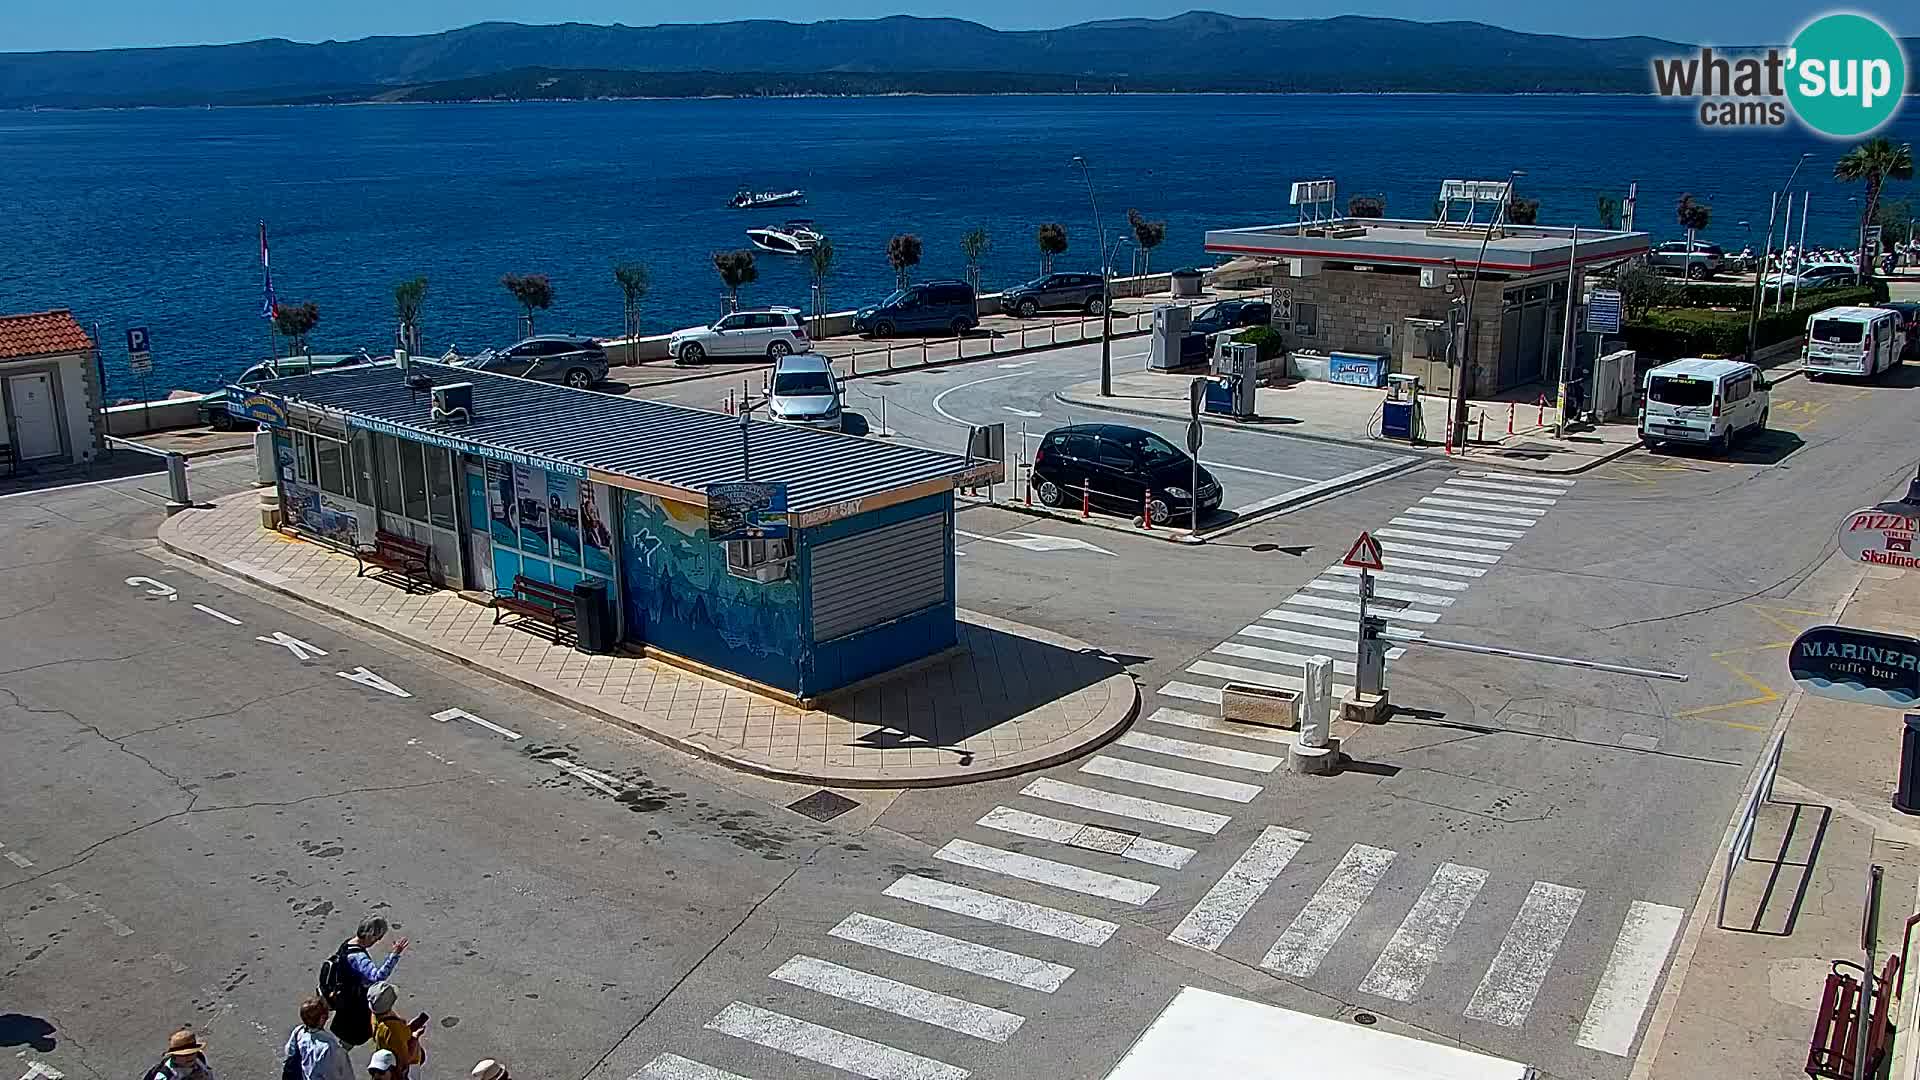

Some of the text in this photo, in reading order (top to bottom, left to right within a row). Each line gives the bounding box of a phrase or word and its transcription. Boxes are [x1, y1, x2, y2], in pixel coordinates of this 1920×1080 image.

[437, 437, 469, 452] POSTAJA
[479, 446, 495, 458] BUS
[495, 449, 528, 465] STATION
[529, 457, 555, 471] TICKET
[556, 463, 583, 477] OFFICE
[1849, 515, 1920, 532] PIZZE
[1801, 641, 1920, 674] MARINER
[1830, 661, 1898, 680] caffe bar
